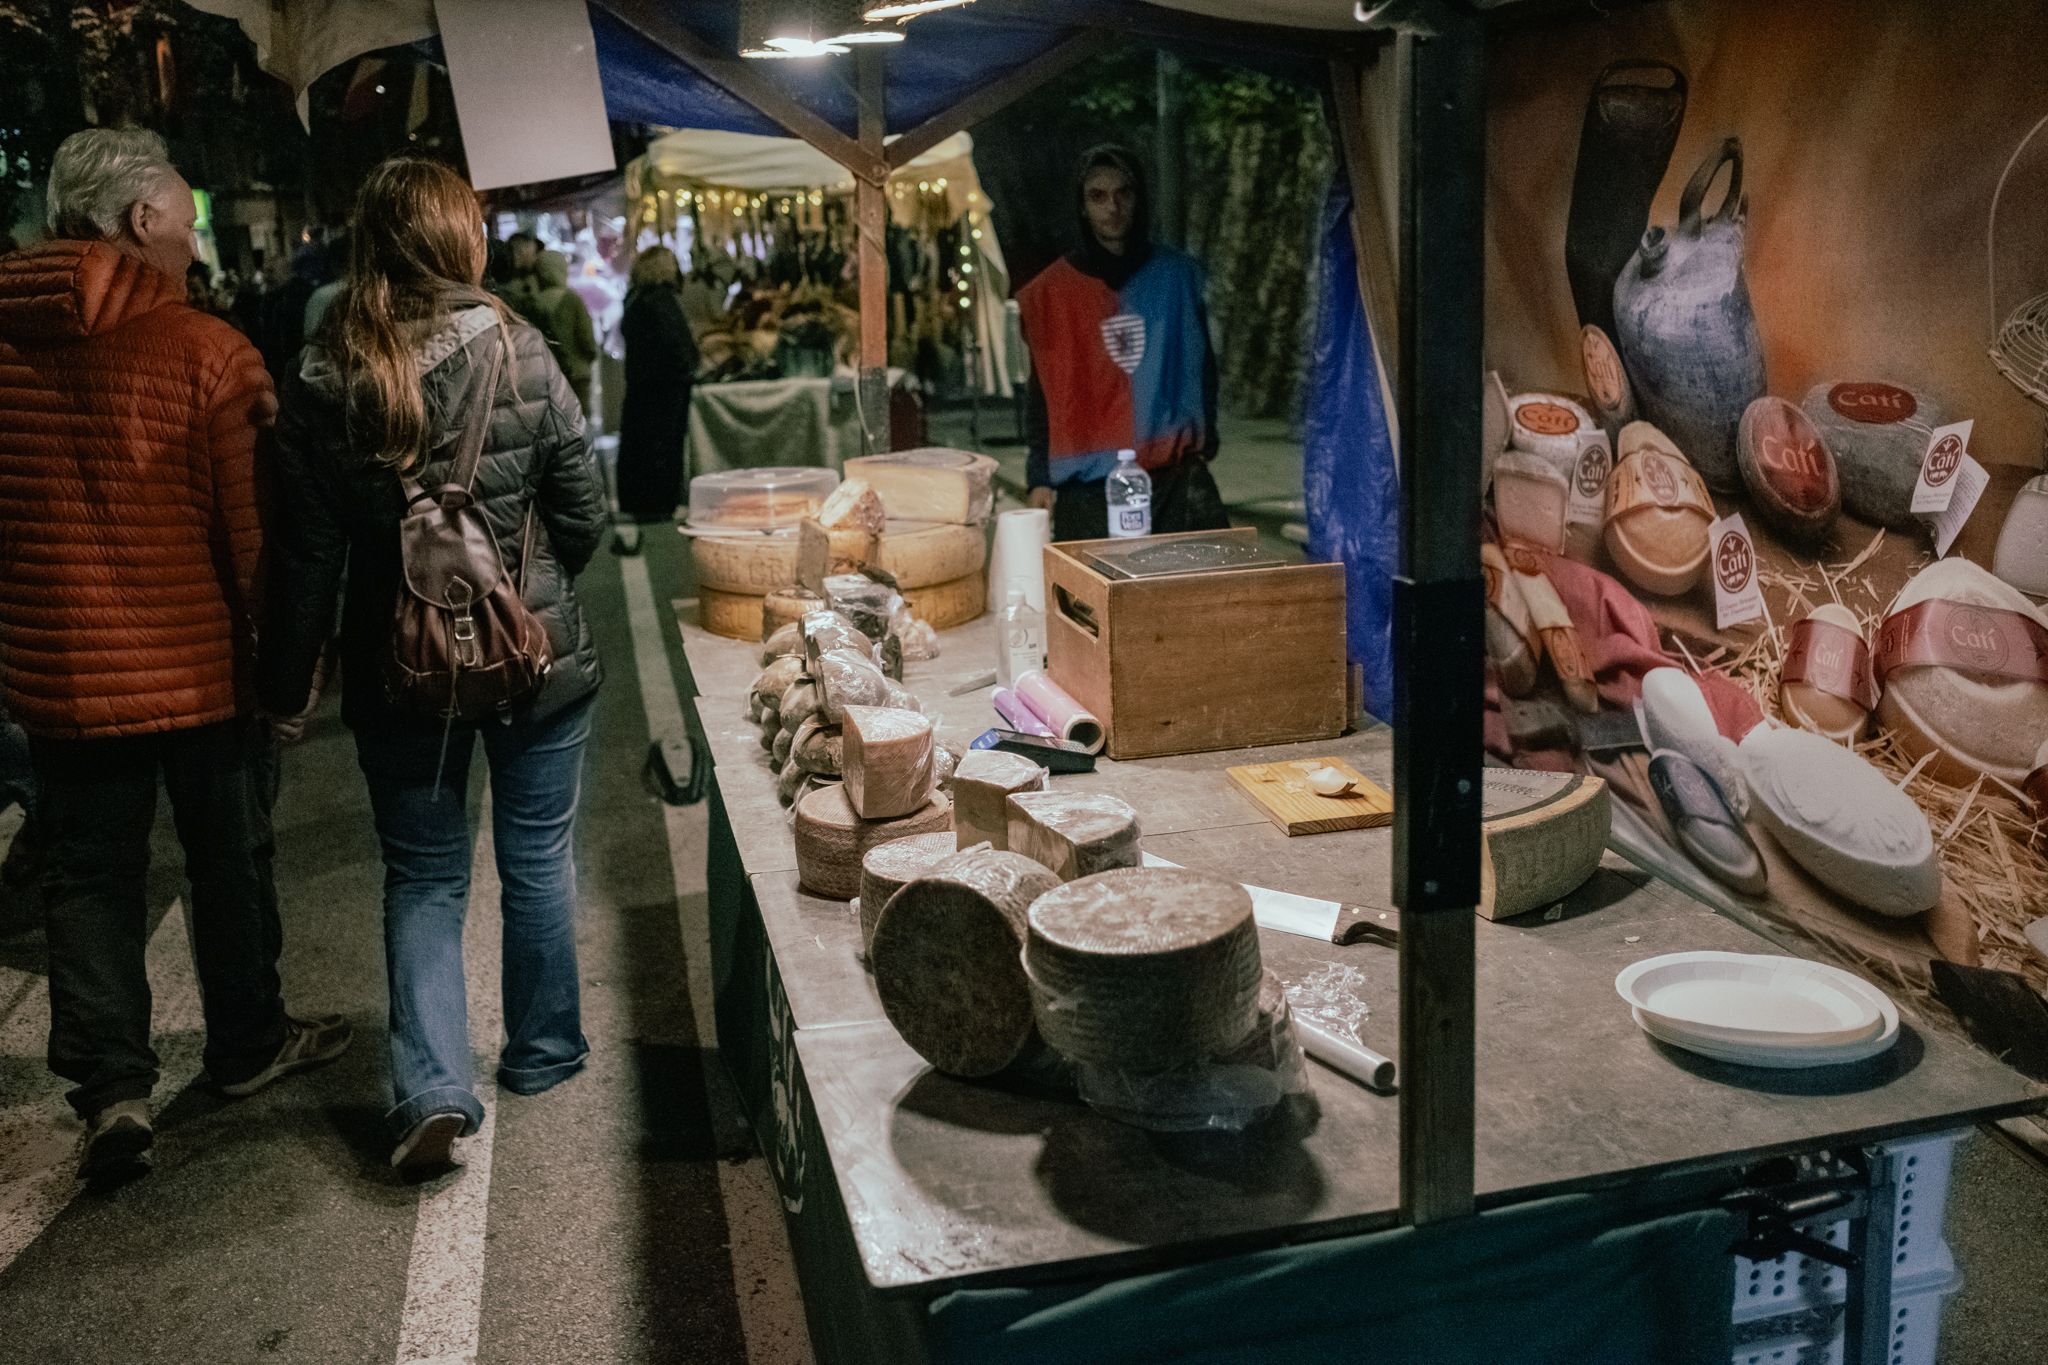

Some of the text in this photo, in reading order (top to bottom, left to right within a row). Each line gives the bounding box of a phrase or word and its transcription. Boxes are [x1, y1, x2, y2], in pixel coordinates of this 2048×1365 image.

[1762, 435, 1820, 477] Catí
[1929, 447, 1960, 471] Catí
[1720, 542, 1748, 577] Catí
[1951, 625, 1996, 651] Catí
